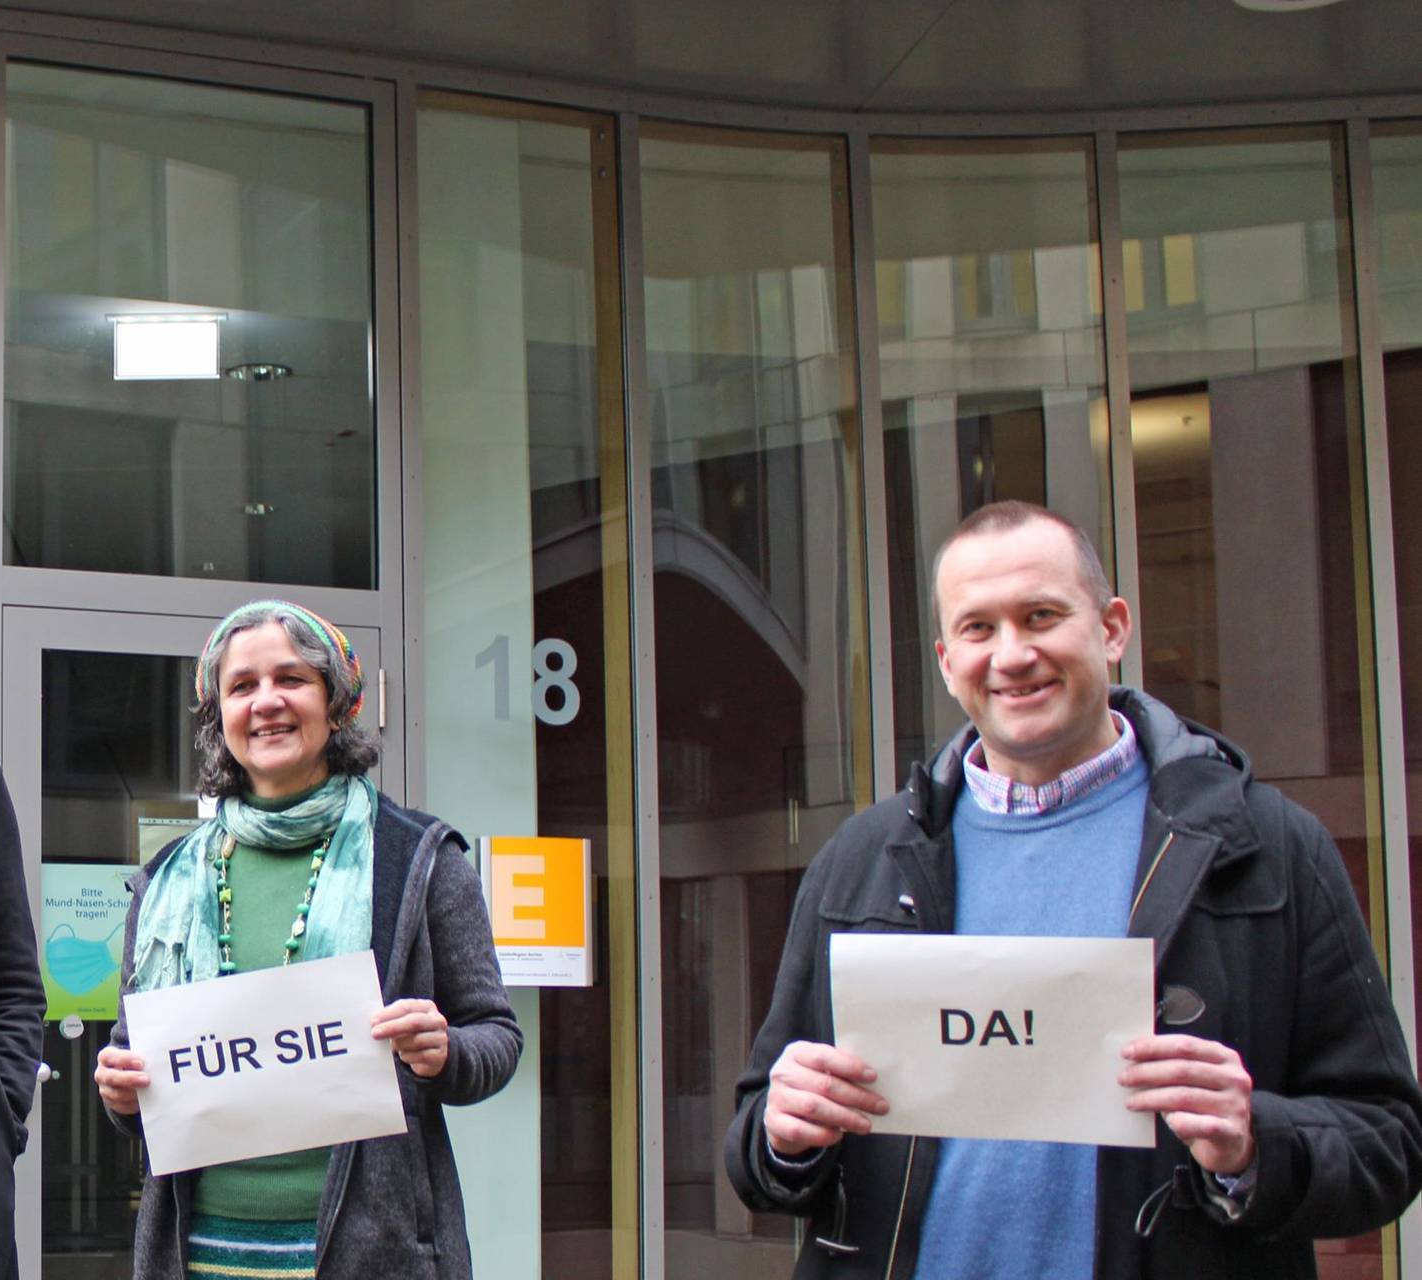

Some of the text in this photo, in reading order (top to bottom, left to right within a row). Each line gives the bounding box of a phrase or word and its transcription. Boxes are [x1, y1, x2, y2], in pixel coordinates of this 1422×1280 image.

[475, 635, 580, 726] 18
[45, 898, 131, 908] Mund-Nasen-Schu
[81, 887, 104, 897] Bitte
[491, 854, 546, 939] E
[75, 910, 109, 921] tragen!
[940, 1008, 1034, 1046] DA!
[168, 1020, 348, 1083] FÜR SIE
